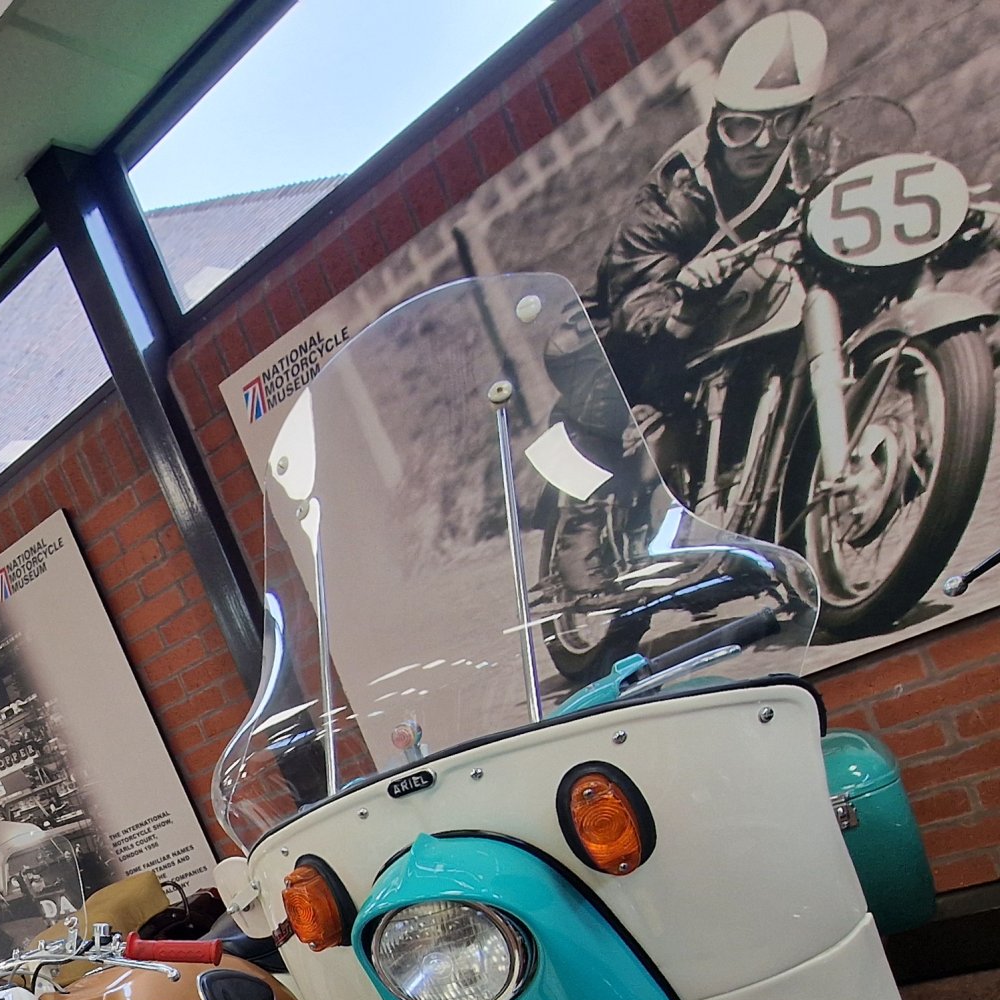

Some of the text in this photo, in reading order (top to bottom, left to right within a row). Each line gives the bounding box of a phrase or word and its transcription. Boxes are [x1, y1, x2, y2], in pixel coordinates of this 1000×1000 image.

[831, 162, 941, 258] 55
[262, 331, 325, 381] NATIONAL
[264, 326, 350, 396] MOTORCYCLE
[267, 363, 321, 411] MUSEUM
[6, 538, 48, 572] NATIONAL
[8, 537, 65, 583] MOTORCYCLE
[11, 562, 48, 594] MUSEUM
[393, 775, 429, 795] ARIEL
[109, 811, 171, 841] THE INTERNATIONAL
[112, 818, 174, 848] MOTORCYCLE SHOW,
[115, 843, 135, 855] EARLS
[118, 848, 144, 862] LONDON
[125, 844, 195, 876] SOME FAMILIAR NAMES
[176, 855, 190, 864] AND
